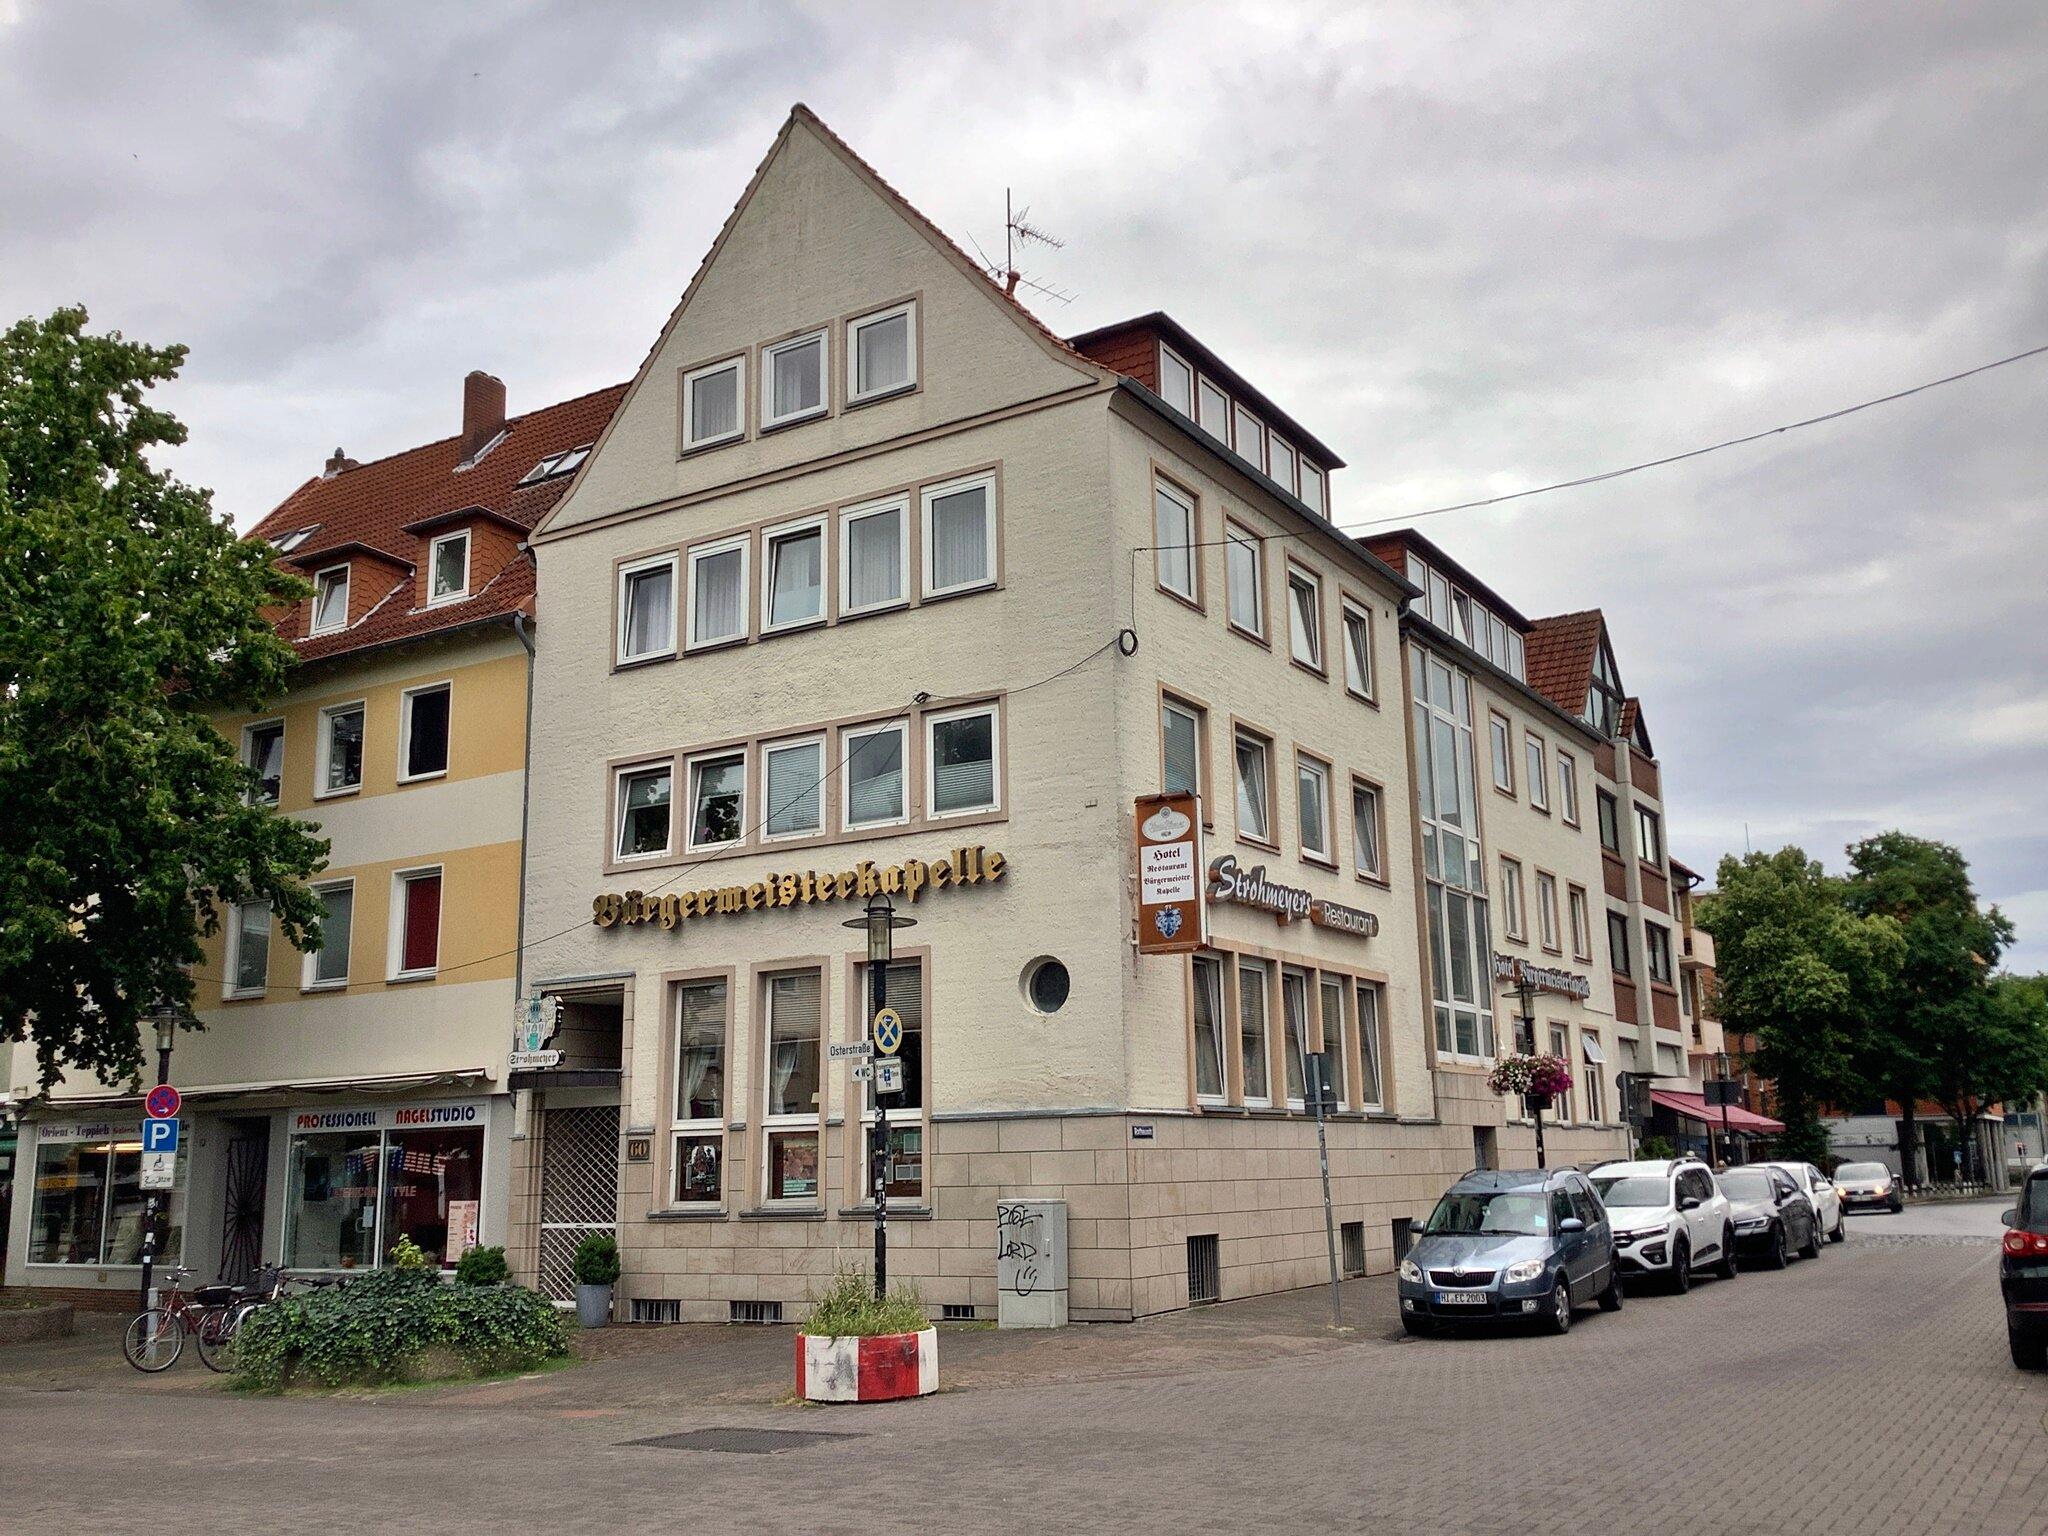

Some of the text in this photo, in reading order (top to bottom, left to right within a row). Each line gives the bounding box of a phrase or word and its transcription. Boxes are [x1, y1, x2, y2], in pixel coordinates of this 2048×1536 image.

[1153, 847, 1181, 861] Hotel
[1147, 862, 1188, 873] Restaurant
[593, 845, 1007, 930] Bürgermeisterkapelle
[1156, 887, 1181, 896] Kapelle
[1214, 858, 1373, 933] Strohmeyers Restaurant
[830, 1043, 871, 1057] Osterstraße
[860, 1067, 871, 1078] WC
[297, 1106, 476, 1129] PROFESSIONELL NAGELSTUDIO
[151, 1123, 171, 1150] P
[1441, 1293, 1450, 1303] HI
[1466, 1293, 1486, 1303] 2003
